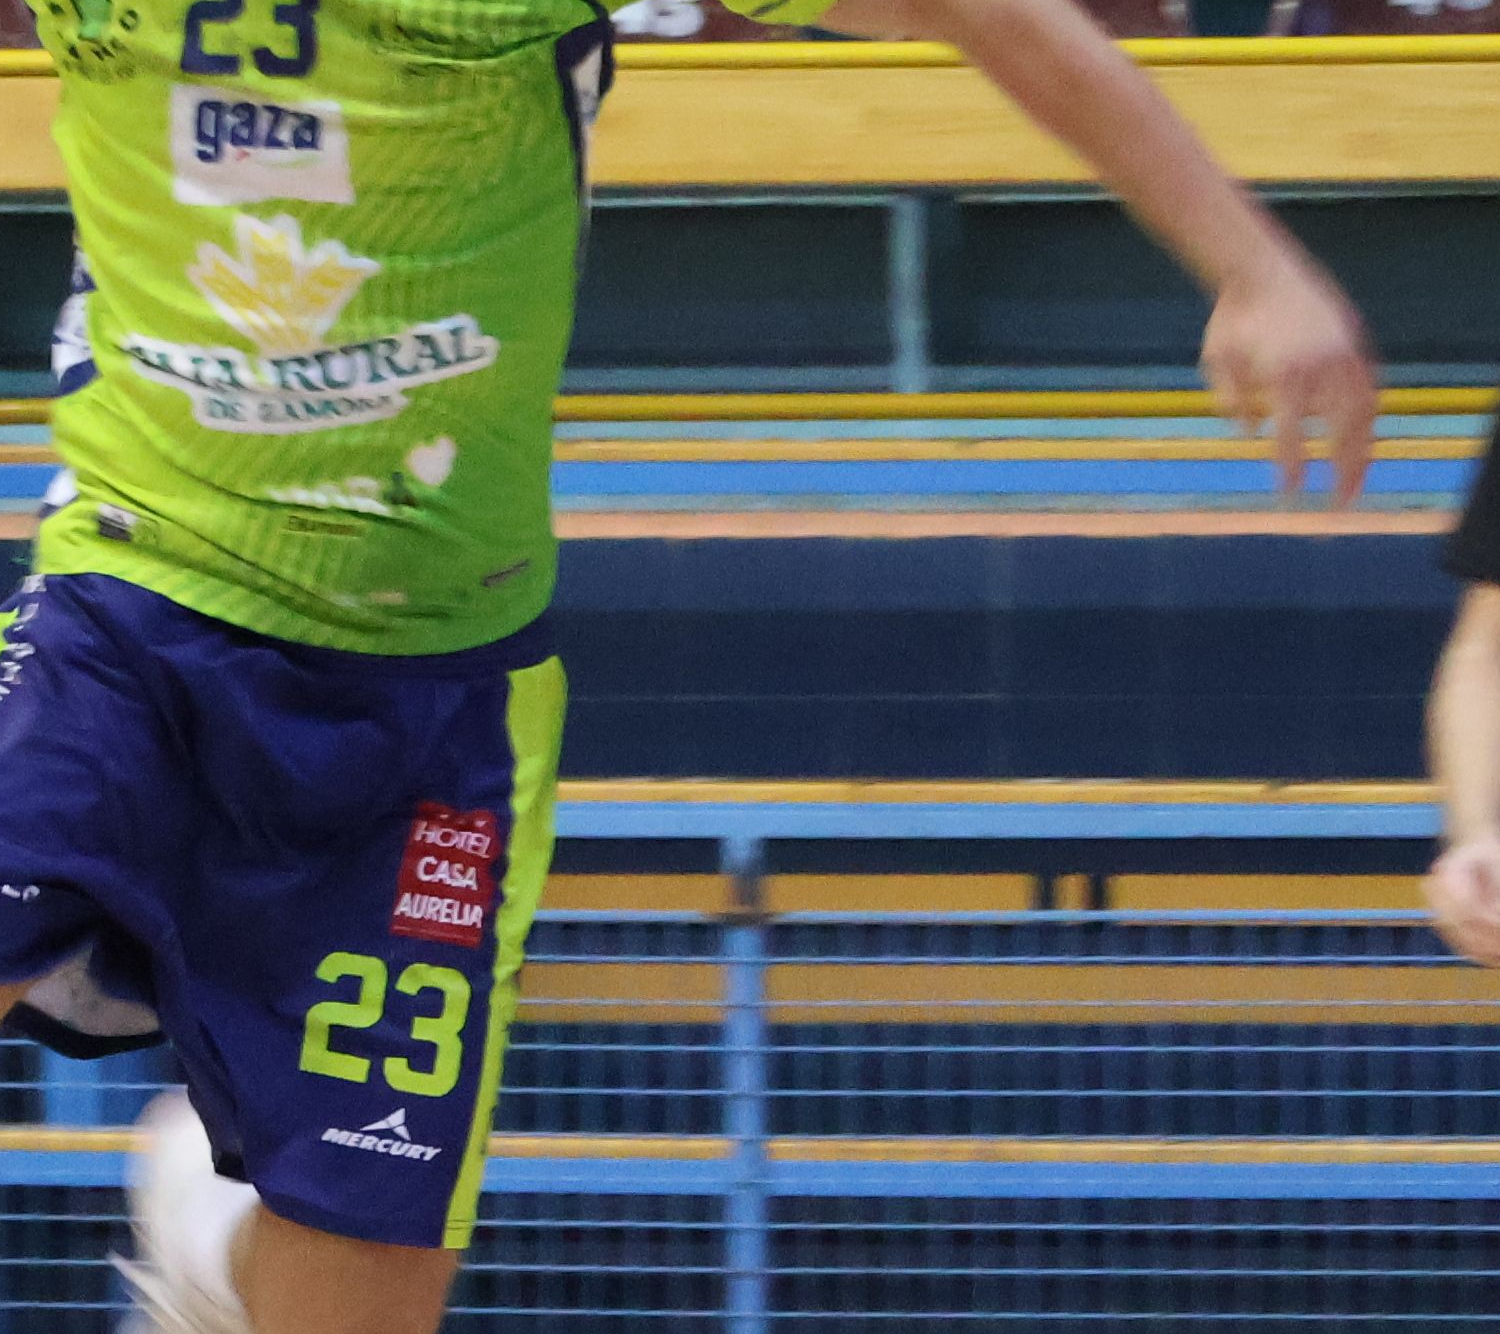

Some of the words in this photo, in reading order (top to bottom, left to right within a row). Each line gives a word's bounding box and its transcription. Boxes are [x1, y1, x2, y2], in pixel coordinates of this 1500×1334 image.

[195, 99, 324, 163] gaza
[268, 325, 487, 393] RURAL
[414, 820, 492, 859] HOTEL
[416, 855, 479, 891] CASA
[393, 891, 484, 929] AURELIA
[299, 951, 471, 1098] 23
[320, 1127, 443, 1162] MERCURY
